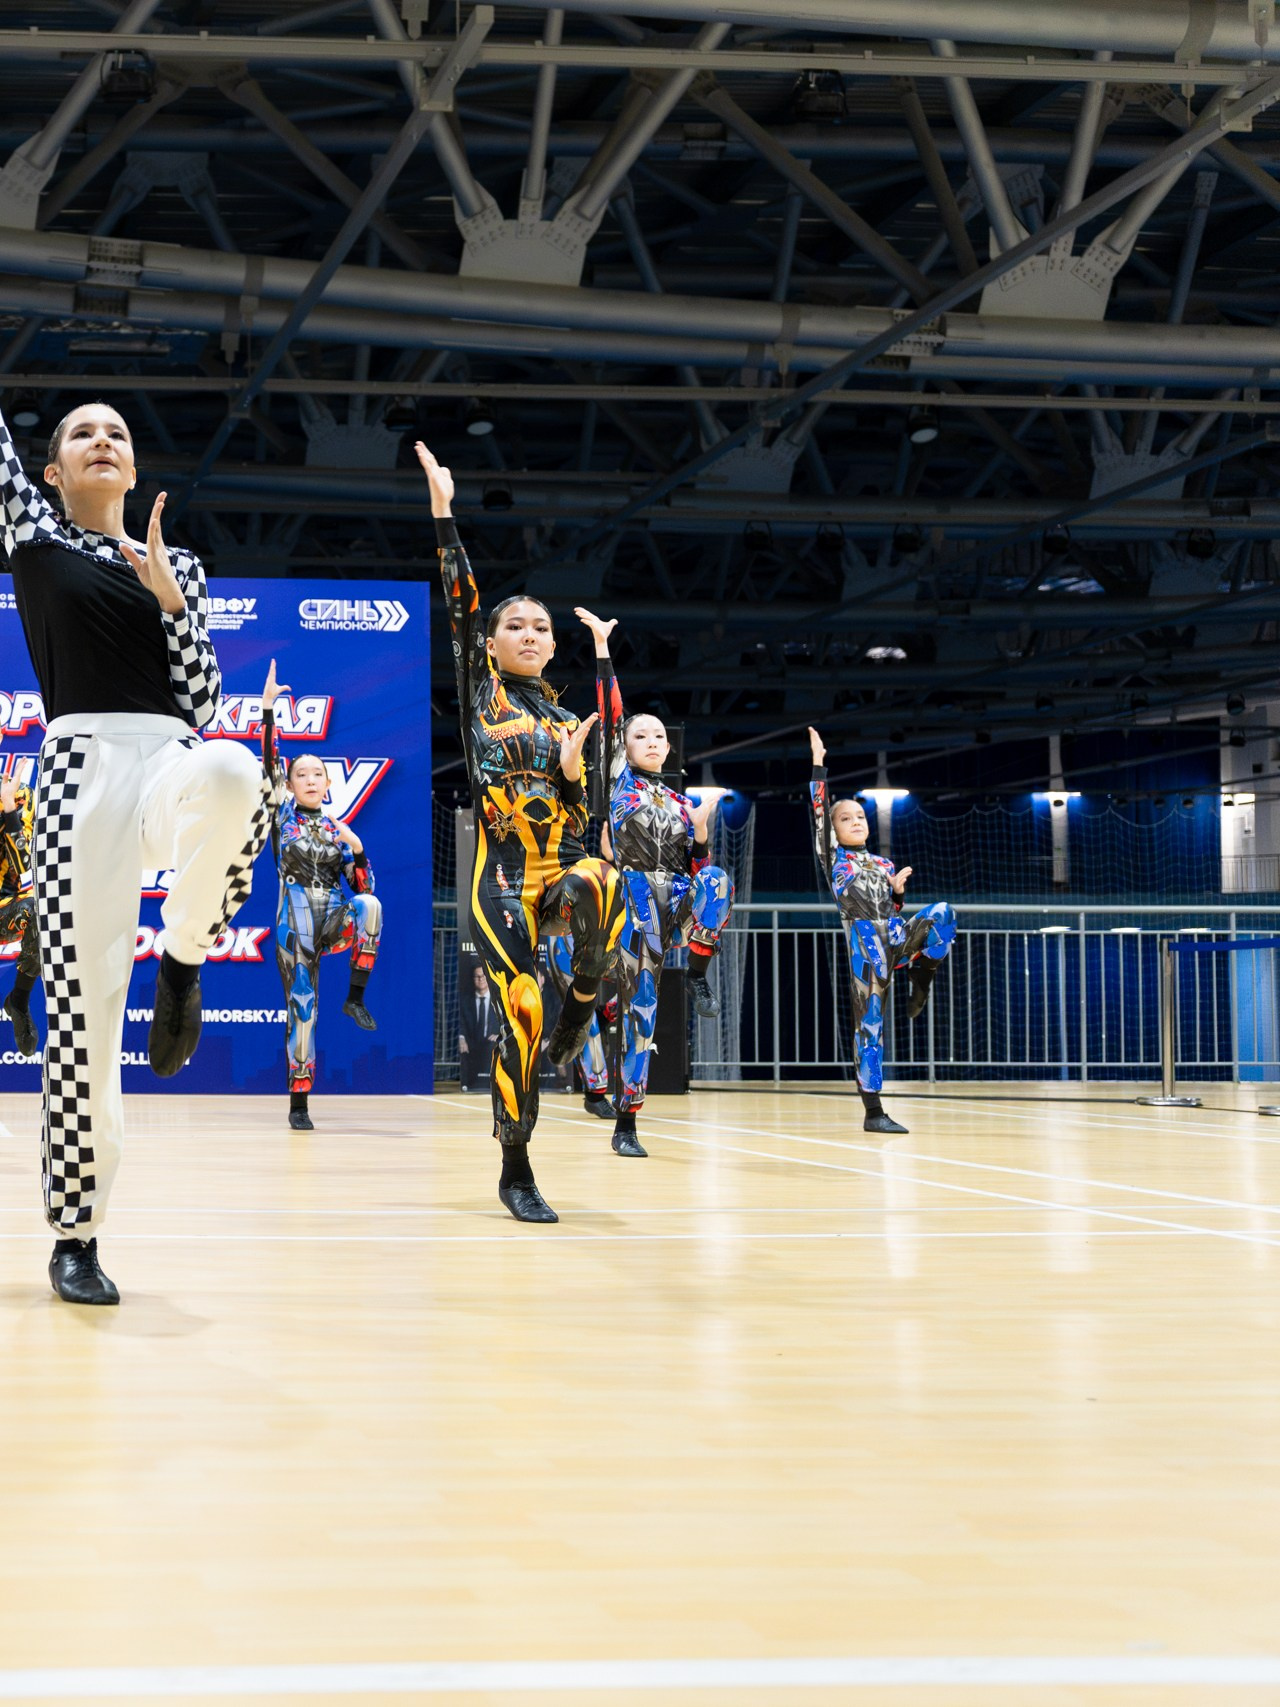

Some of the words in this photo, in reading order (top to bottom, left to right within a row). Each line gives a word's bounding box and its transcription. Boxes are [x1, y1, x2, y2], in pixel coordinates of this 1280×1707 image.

[298, 598, 379, 621] СТАНЬ
[300, 620, 380, 631] ЧЕМПИОНОМ
[203, 694, 329, 735] КРАЯ
